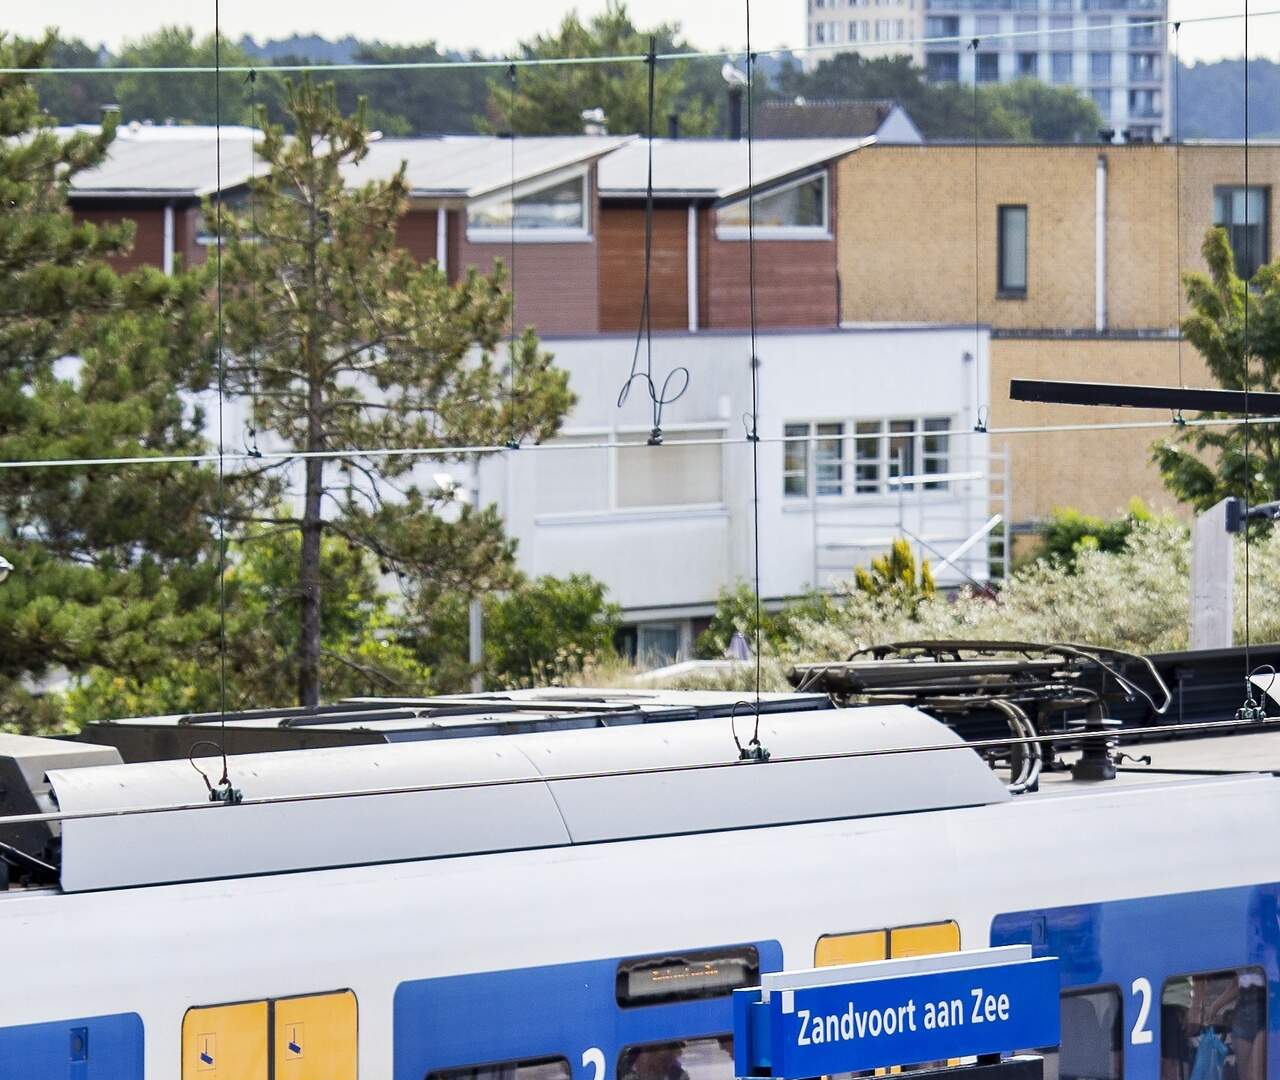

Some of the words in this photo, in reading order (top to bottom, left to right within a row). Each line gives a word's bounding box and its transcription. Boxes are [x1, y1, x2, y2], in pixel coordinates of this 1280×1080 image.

[797, 1000, 917, 1046] Zandvoort
[924, 999, 964, 1031] aan
[971, 988, 1011, 1025] Zee
[1131, 977, 1153, 1046] 2
